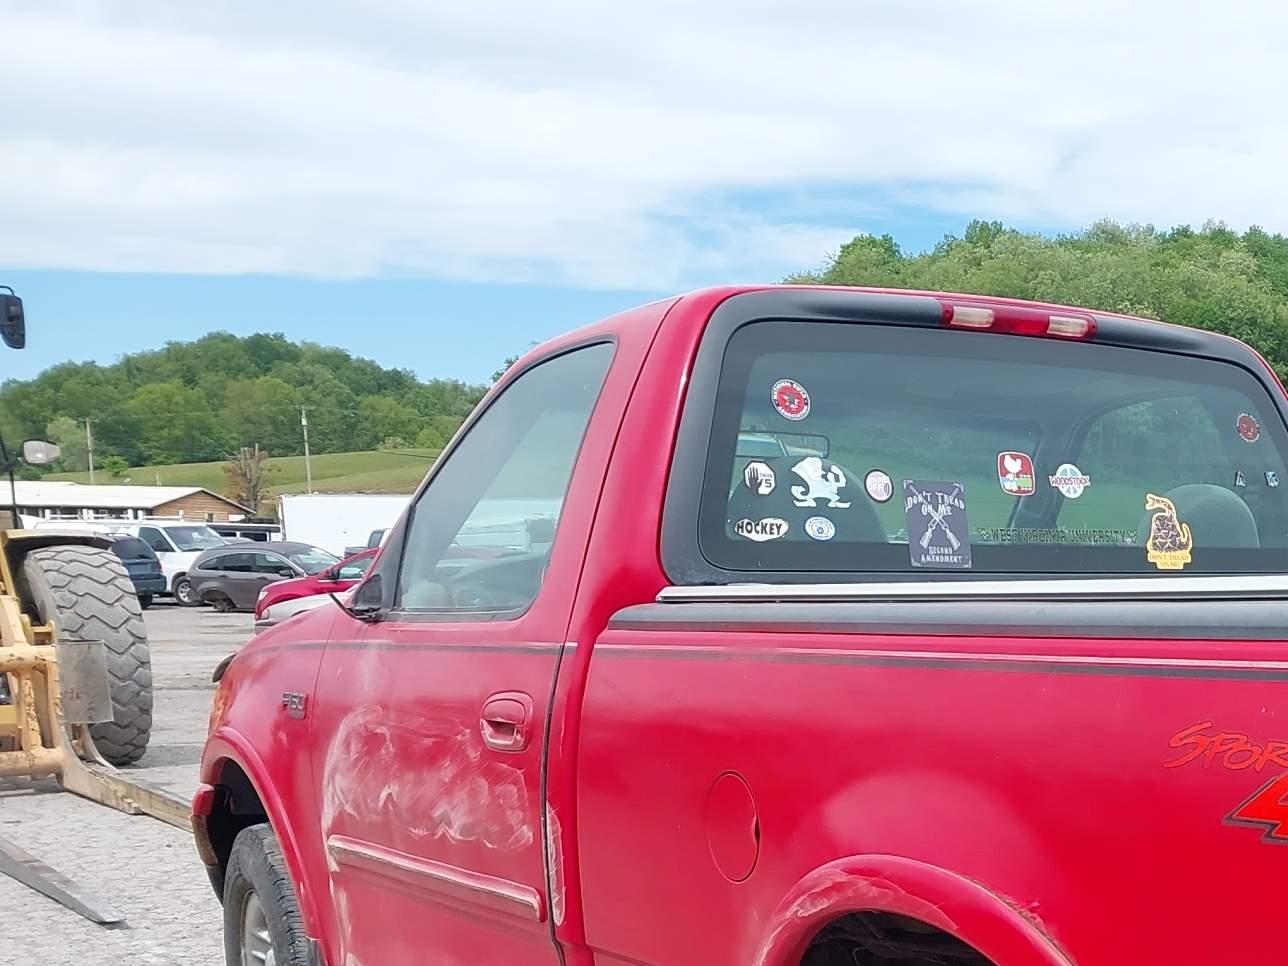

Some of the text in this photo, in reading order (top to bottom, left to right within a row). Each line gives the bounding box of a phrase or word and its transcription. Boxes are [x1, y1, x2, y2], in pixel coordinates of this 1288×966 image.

[1051, 475, 1089, 487] WOODSTOCK
[907, 491, 965, 510] DON'T TREAD
[921, 503, 952, 516] ON ME
[736, 522, 783, 536] HOCKEY
[991, 528, 1018, 543] WEST
[1021, 528, 1066, 543] VIRGINIA
[1069, 529, 1126, 544] UNIVERSITY
[928, 546, 953, 555] SECOND
[920, 554, 962, 564] AMENDMENT
